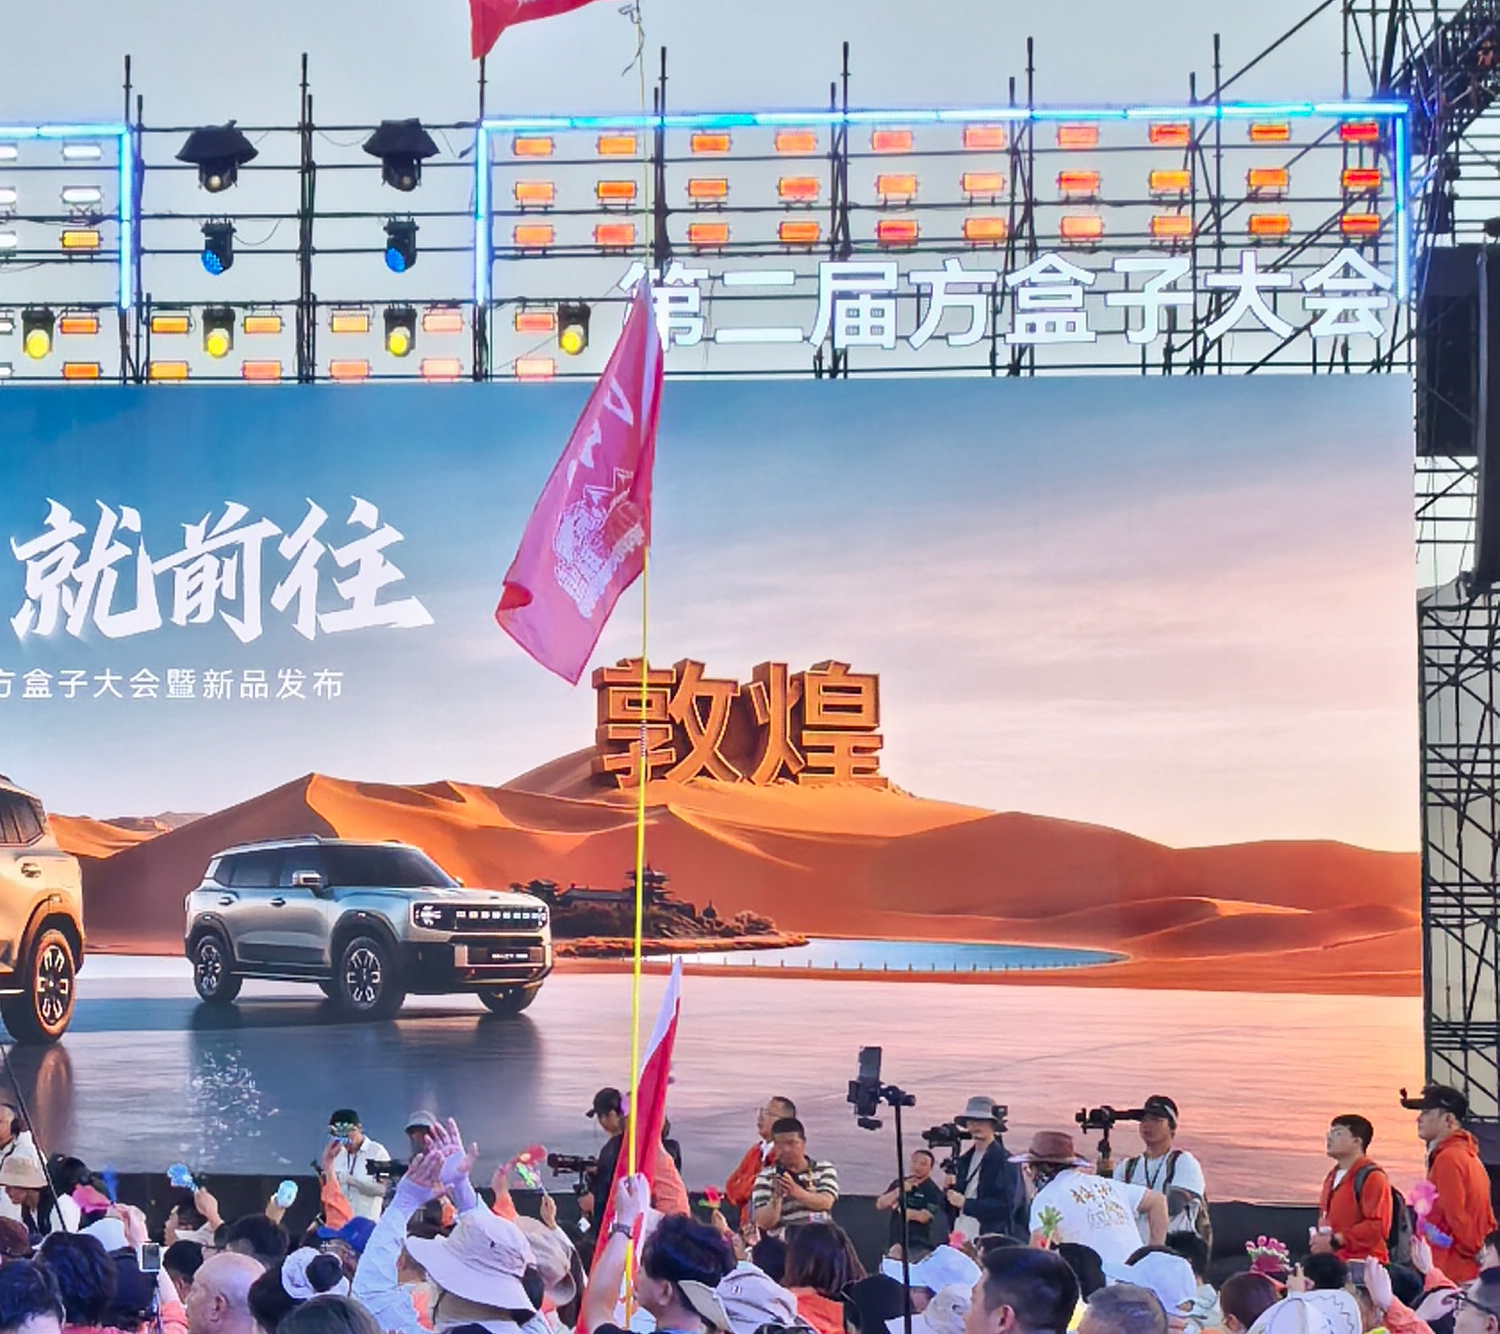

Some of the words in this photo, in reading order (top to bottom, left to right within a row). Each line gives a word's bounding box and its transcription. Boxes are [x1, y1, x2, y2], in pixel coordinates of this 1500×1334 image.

[617, 247, 1394, 354] 第二届方盒子大会
[9, 496, 436, 644] 就前往
[592, 655, 889, 791] 敦煌
